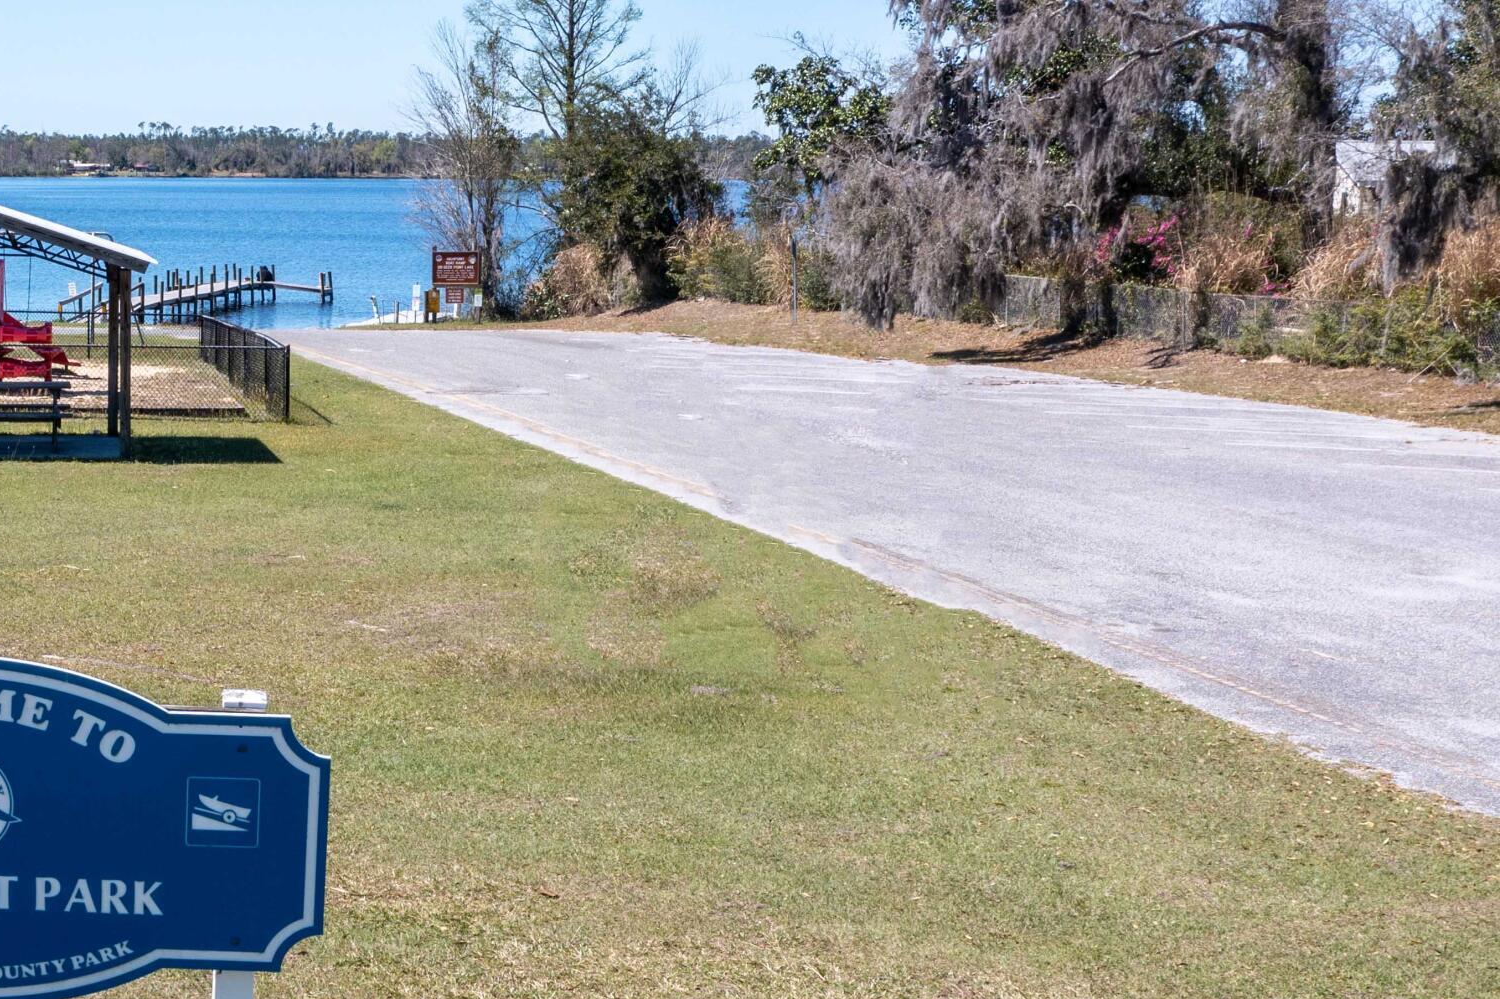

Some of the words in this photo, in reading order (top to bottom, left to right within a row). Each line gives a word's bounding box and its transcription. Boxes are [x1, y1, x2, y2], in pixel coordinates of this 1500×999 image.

[70, 708, 136, 763] TO
[35, 876, 164, 917] PARK
[70, 940, 134, 970] PARK
